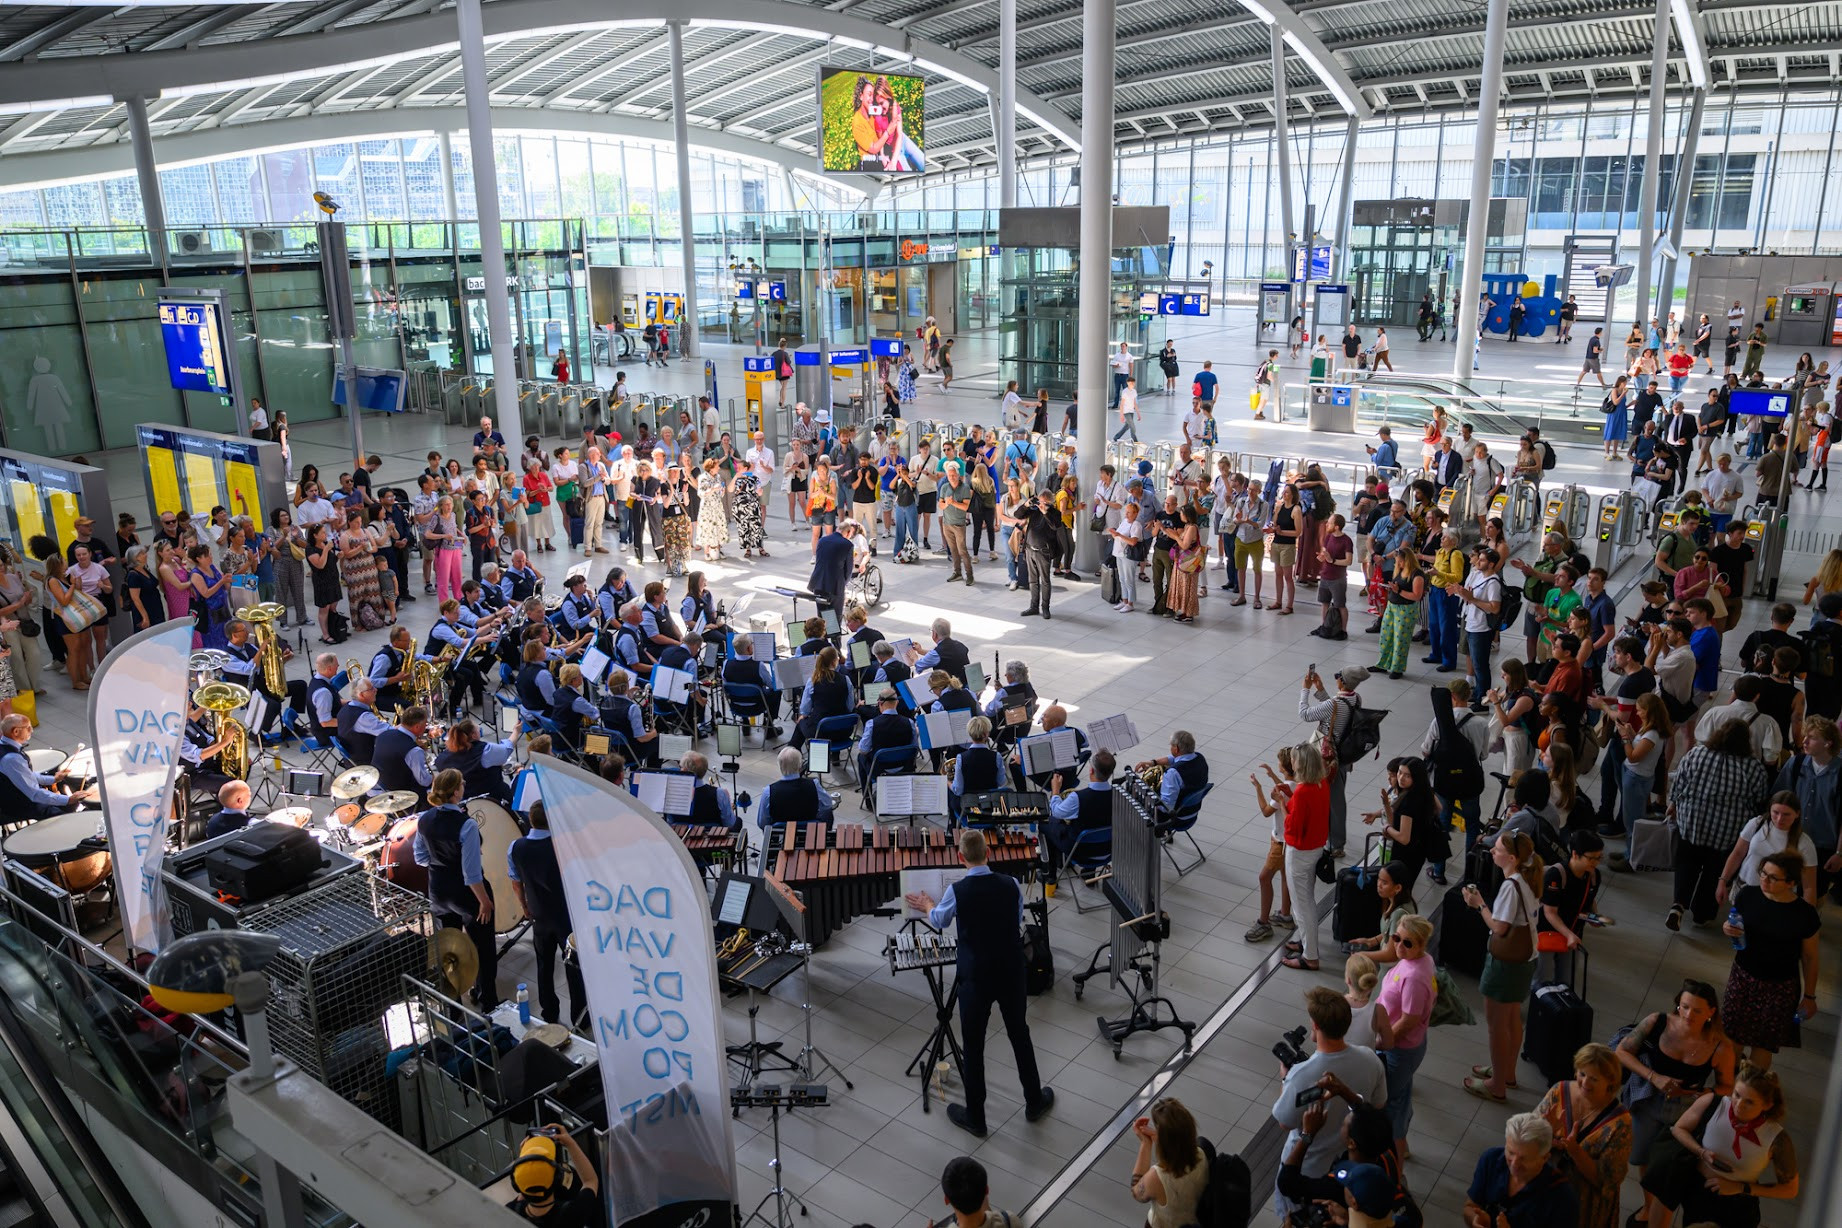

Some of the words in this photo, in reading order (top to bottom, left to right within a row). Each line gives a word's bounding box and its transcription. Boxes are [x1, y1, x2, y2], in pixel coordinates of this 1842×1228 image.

[468, 279, 485, 289] bac
[773, 288, 780, 299] C
[1165, 301, 1175, 314] C
[115, 708, 182, 737] DAG
